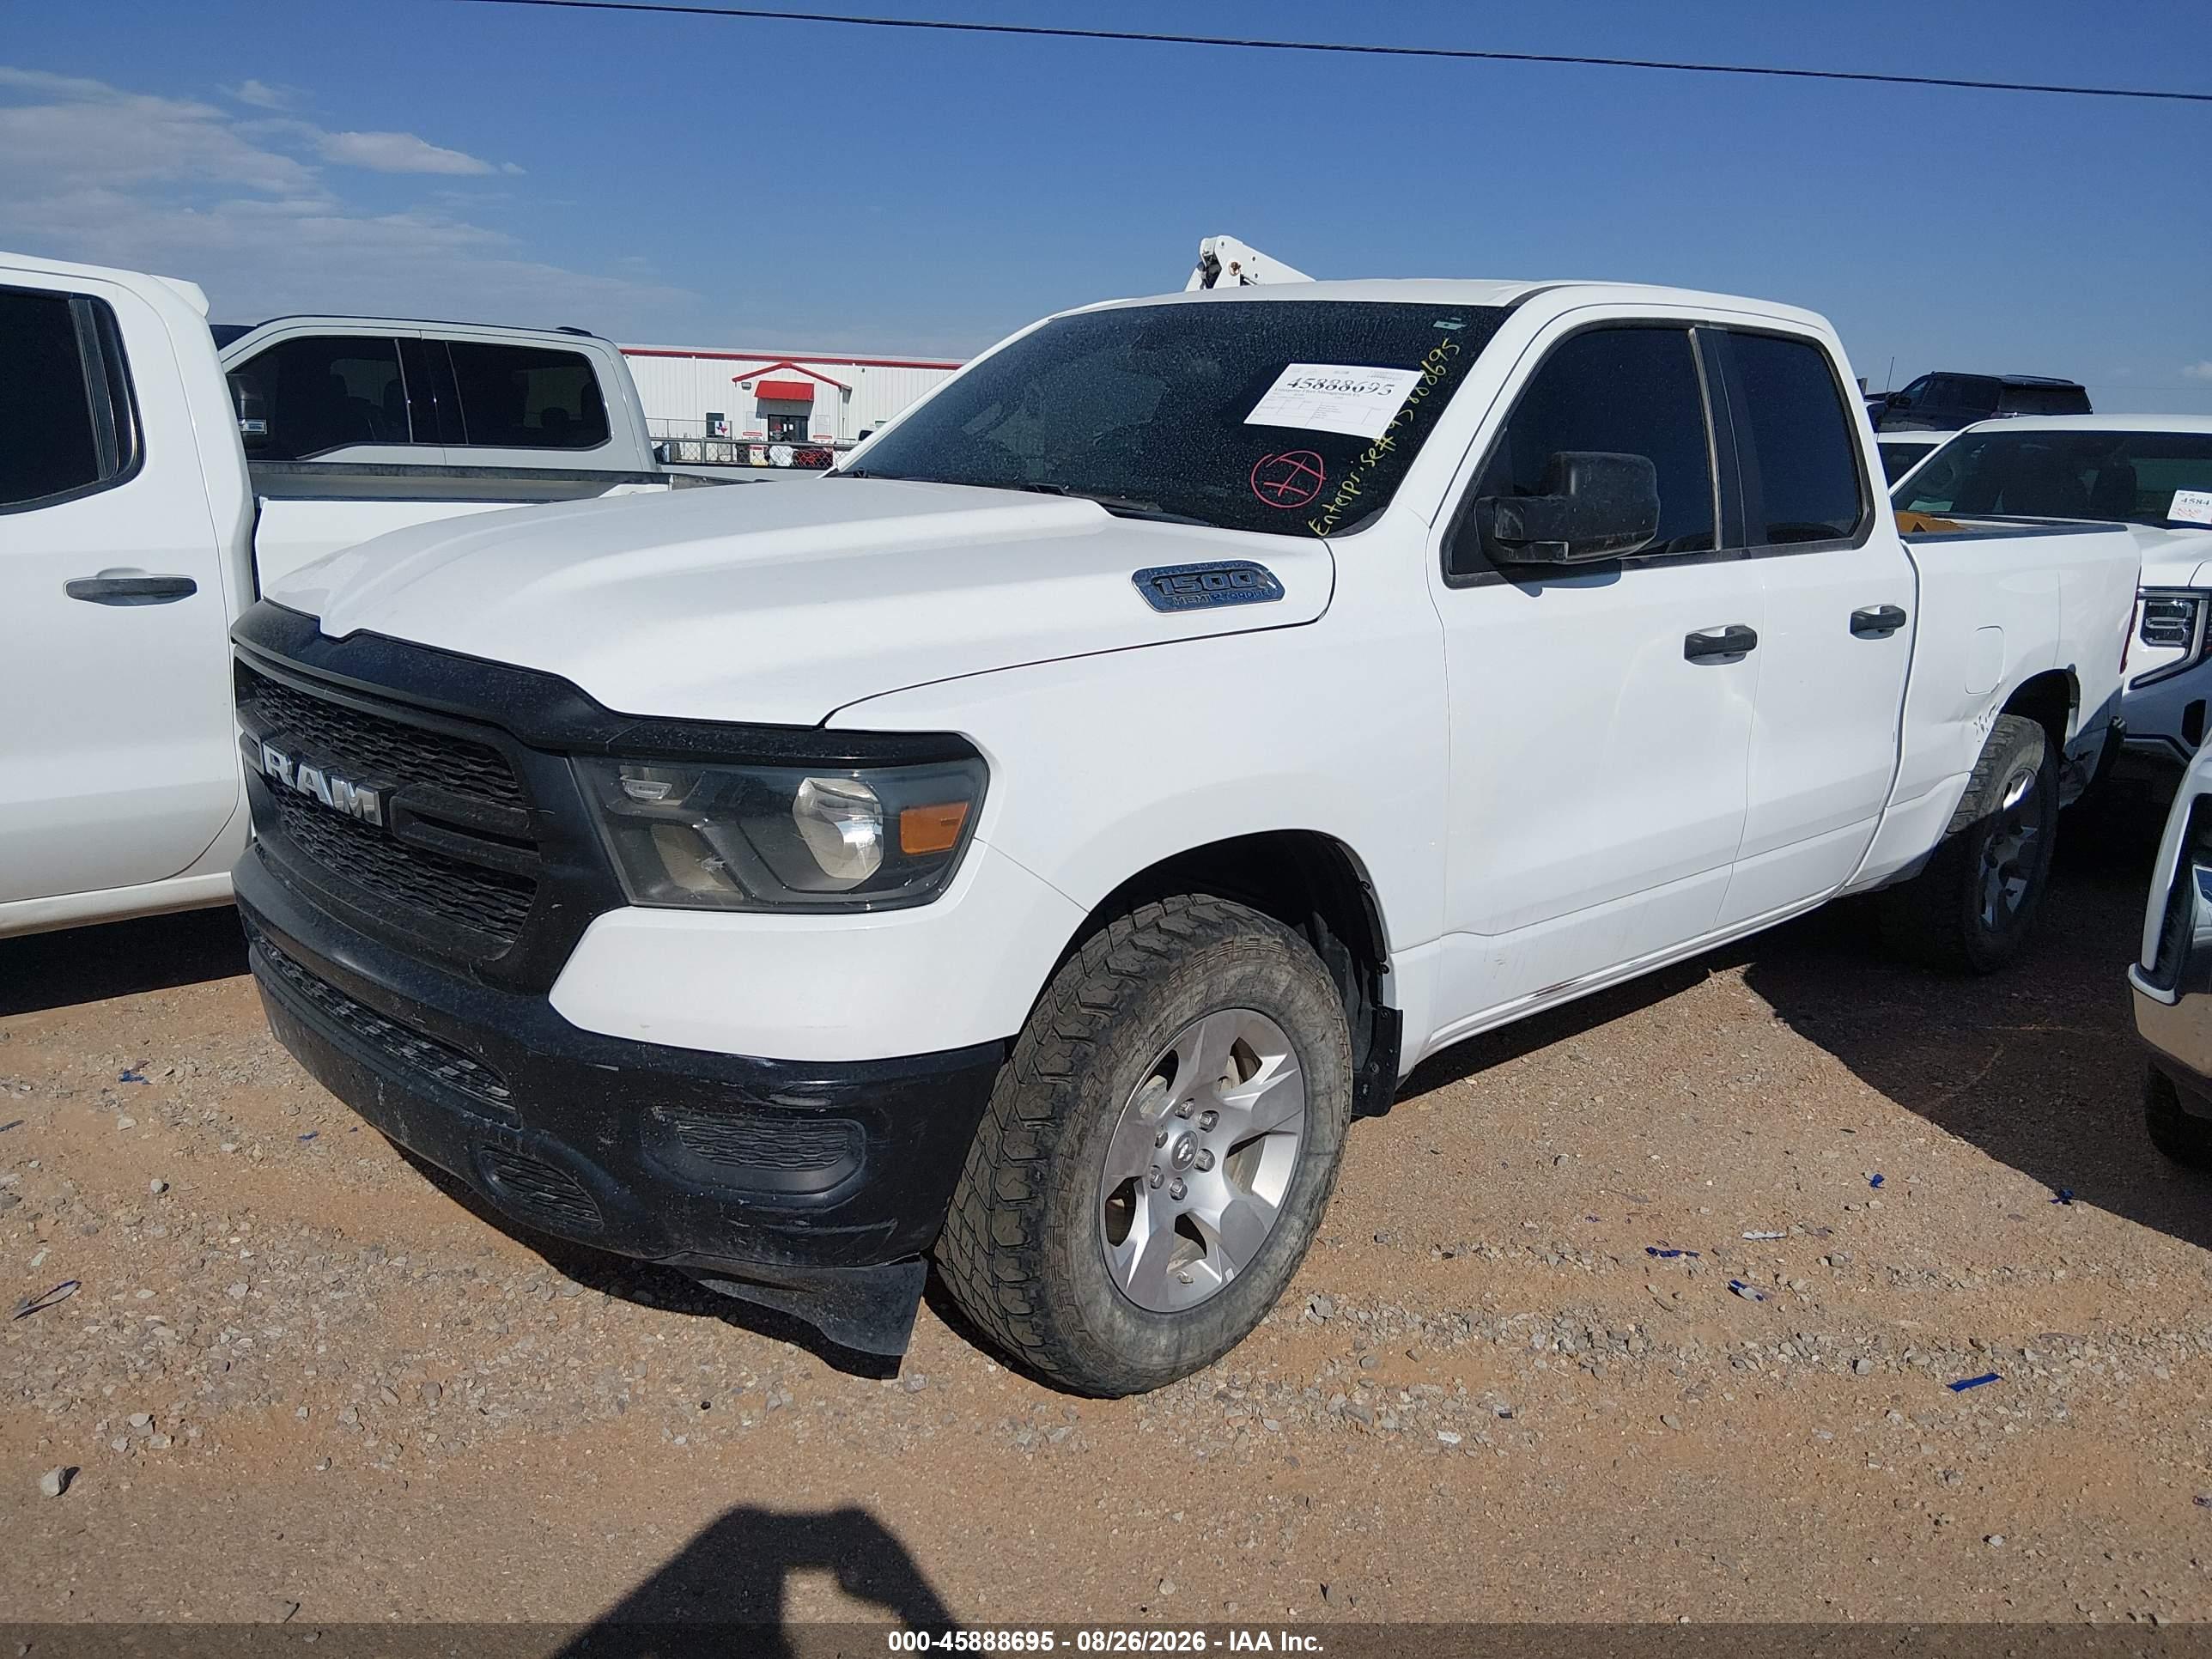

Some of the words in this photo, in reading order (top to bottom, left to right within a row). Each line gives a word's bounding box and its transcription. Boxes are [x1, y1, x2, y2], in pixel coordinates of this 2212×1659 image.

[1286, 377, 1395, 396] 45888695
[1155, 570, 1258, 595] 1500
[263, 741, 383, 827] RAM
